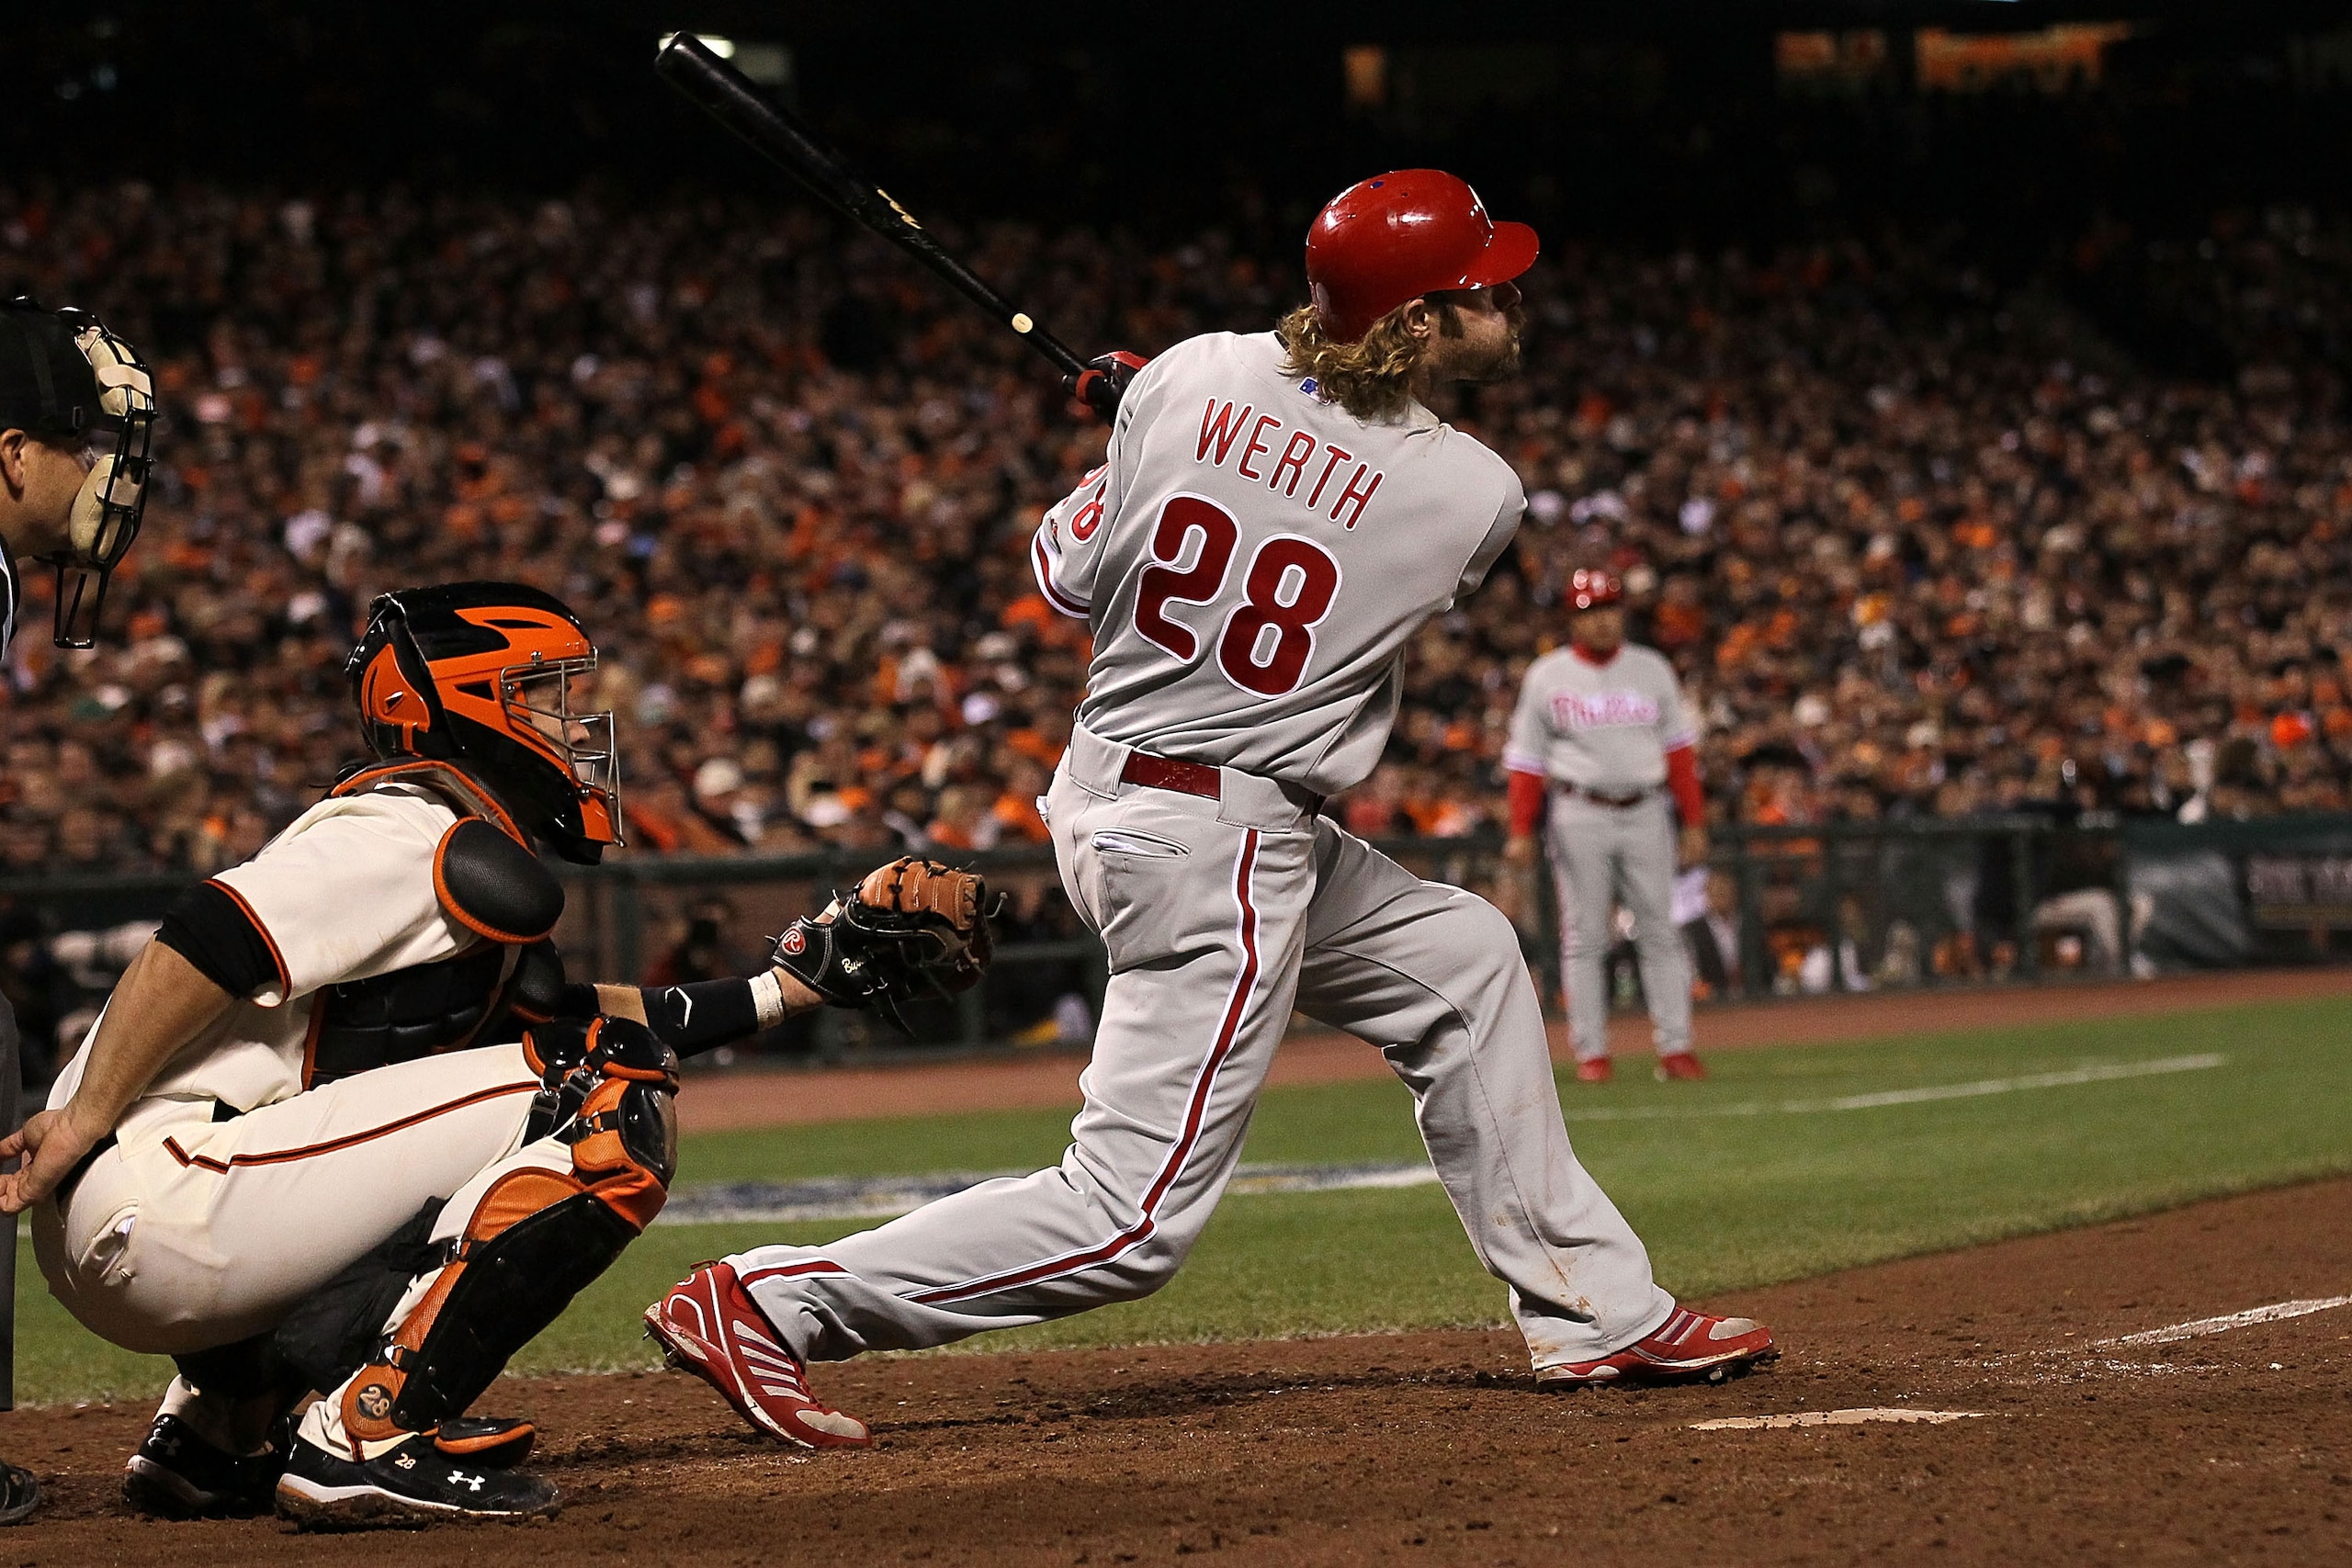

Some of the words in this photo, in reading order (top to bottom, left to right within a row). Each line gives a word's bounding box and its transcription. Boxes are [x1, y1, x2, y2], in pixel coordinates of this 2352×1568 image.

[1194, 395, 1385, 532] WERTH
[1132, 490, 1344, 700] 28
[359, 1385, 390, 1417] 28
[394, 1452, 417, 1470] 28
